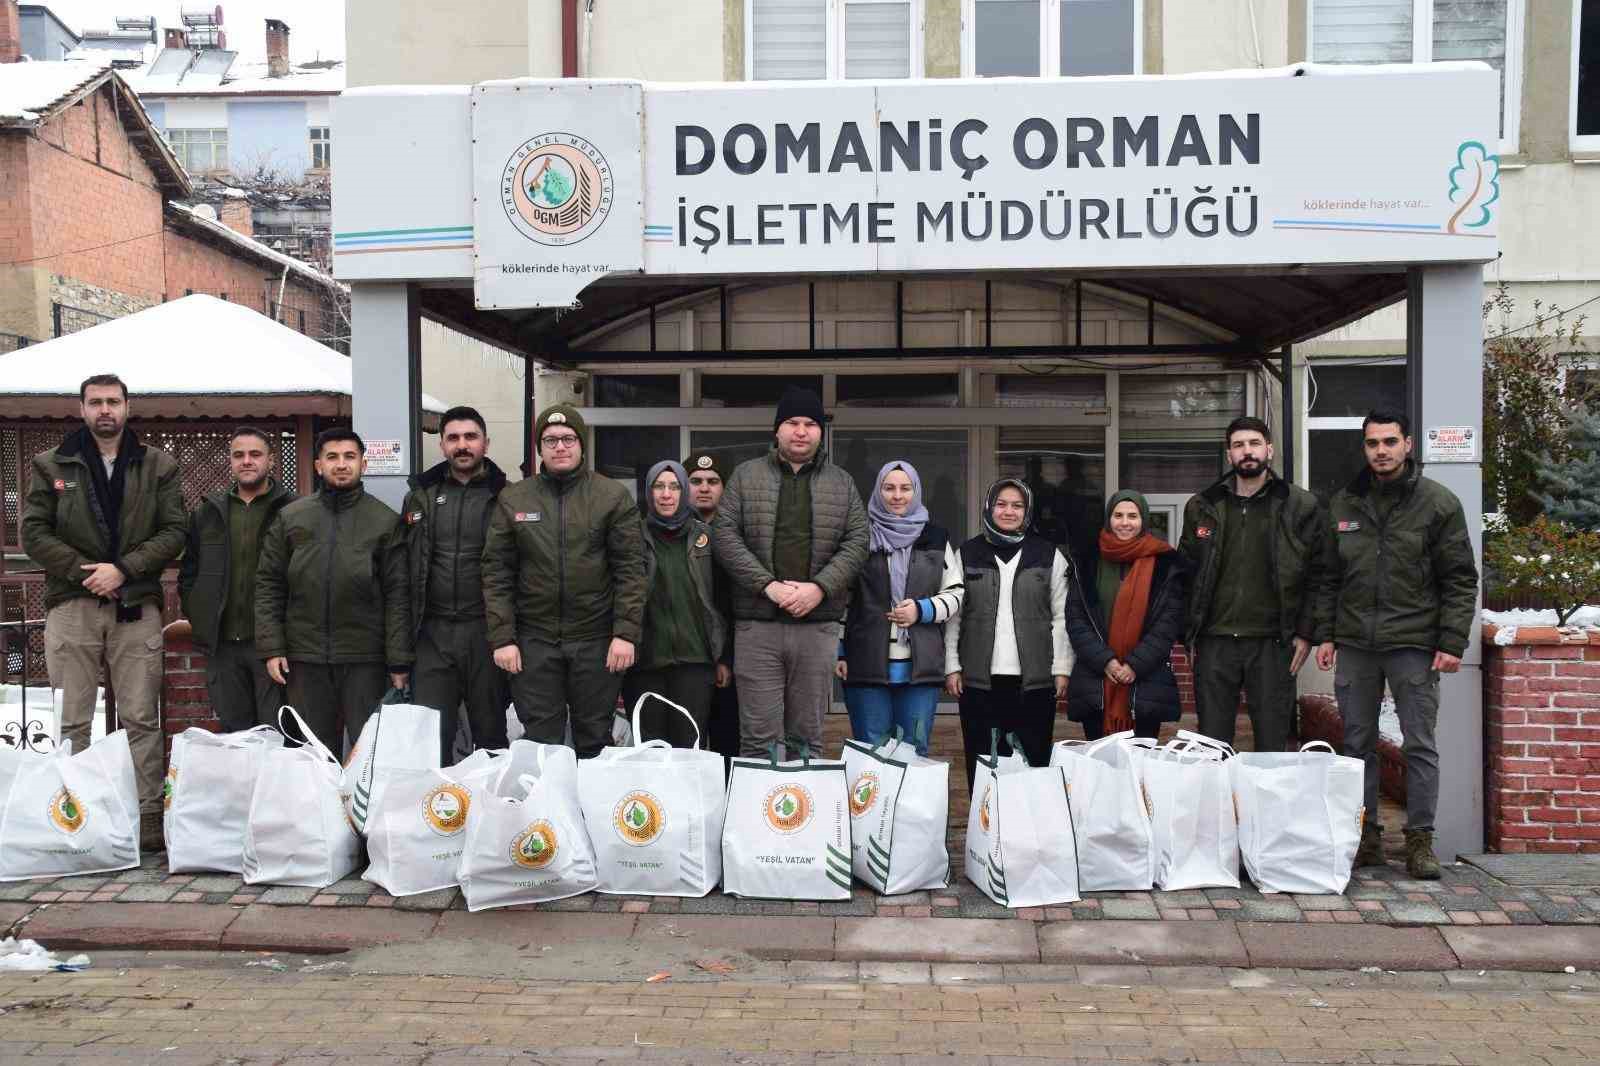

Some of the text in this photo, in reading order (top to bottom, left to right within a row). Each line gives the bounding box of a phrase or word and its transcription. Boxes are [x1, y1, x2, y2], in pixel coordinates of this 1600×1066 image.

[516, 135, 560, 159] GENEL
[1012, 112, 1260, 170] ORMAN
[1304, 199, 1367, 210] köklerinde
[1369, 199, 1401, 211] hayat
[534, 208, 560, 227] OGM
[678, 185, 1258, 254] İŞLETME MÜDÜRLÜĞÜ
[502, 263, 560, 274] köklerinde
[562, 263, 592, 276] hayat
